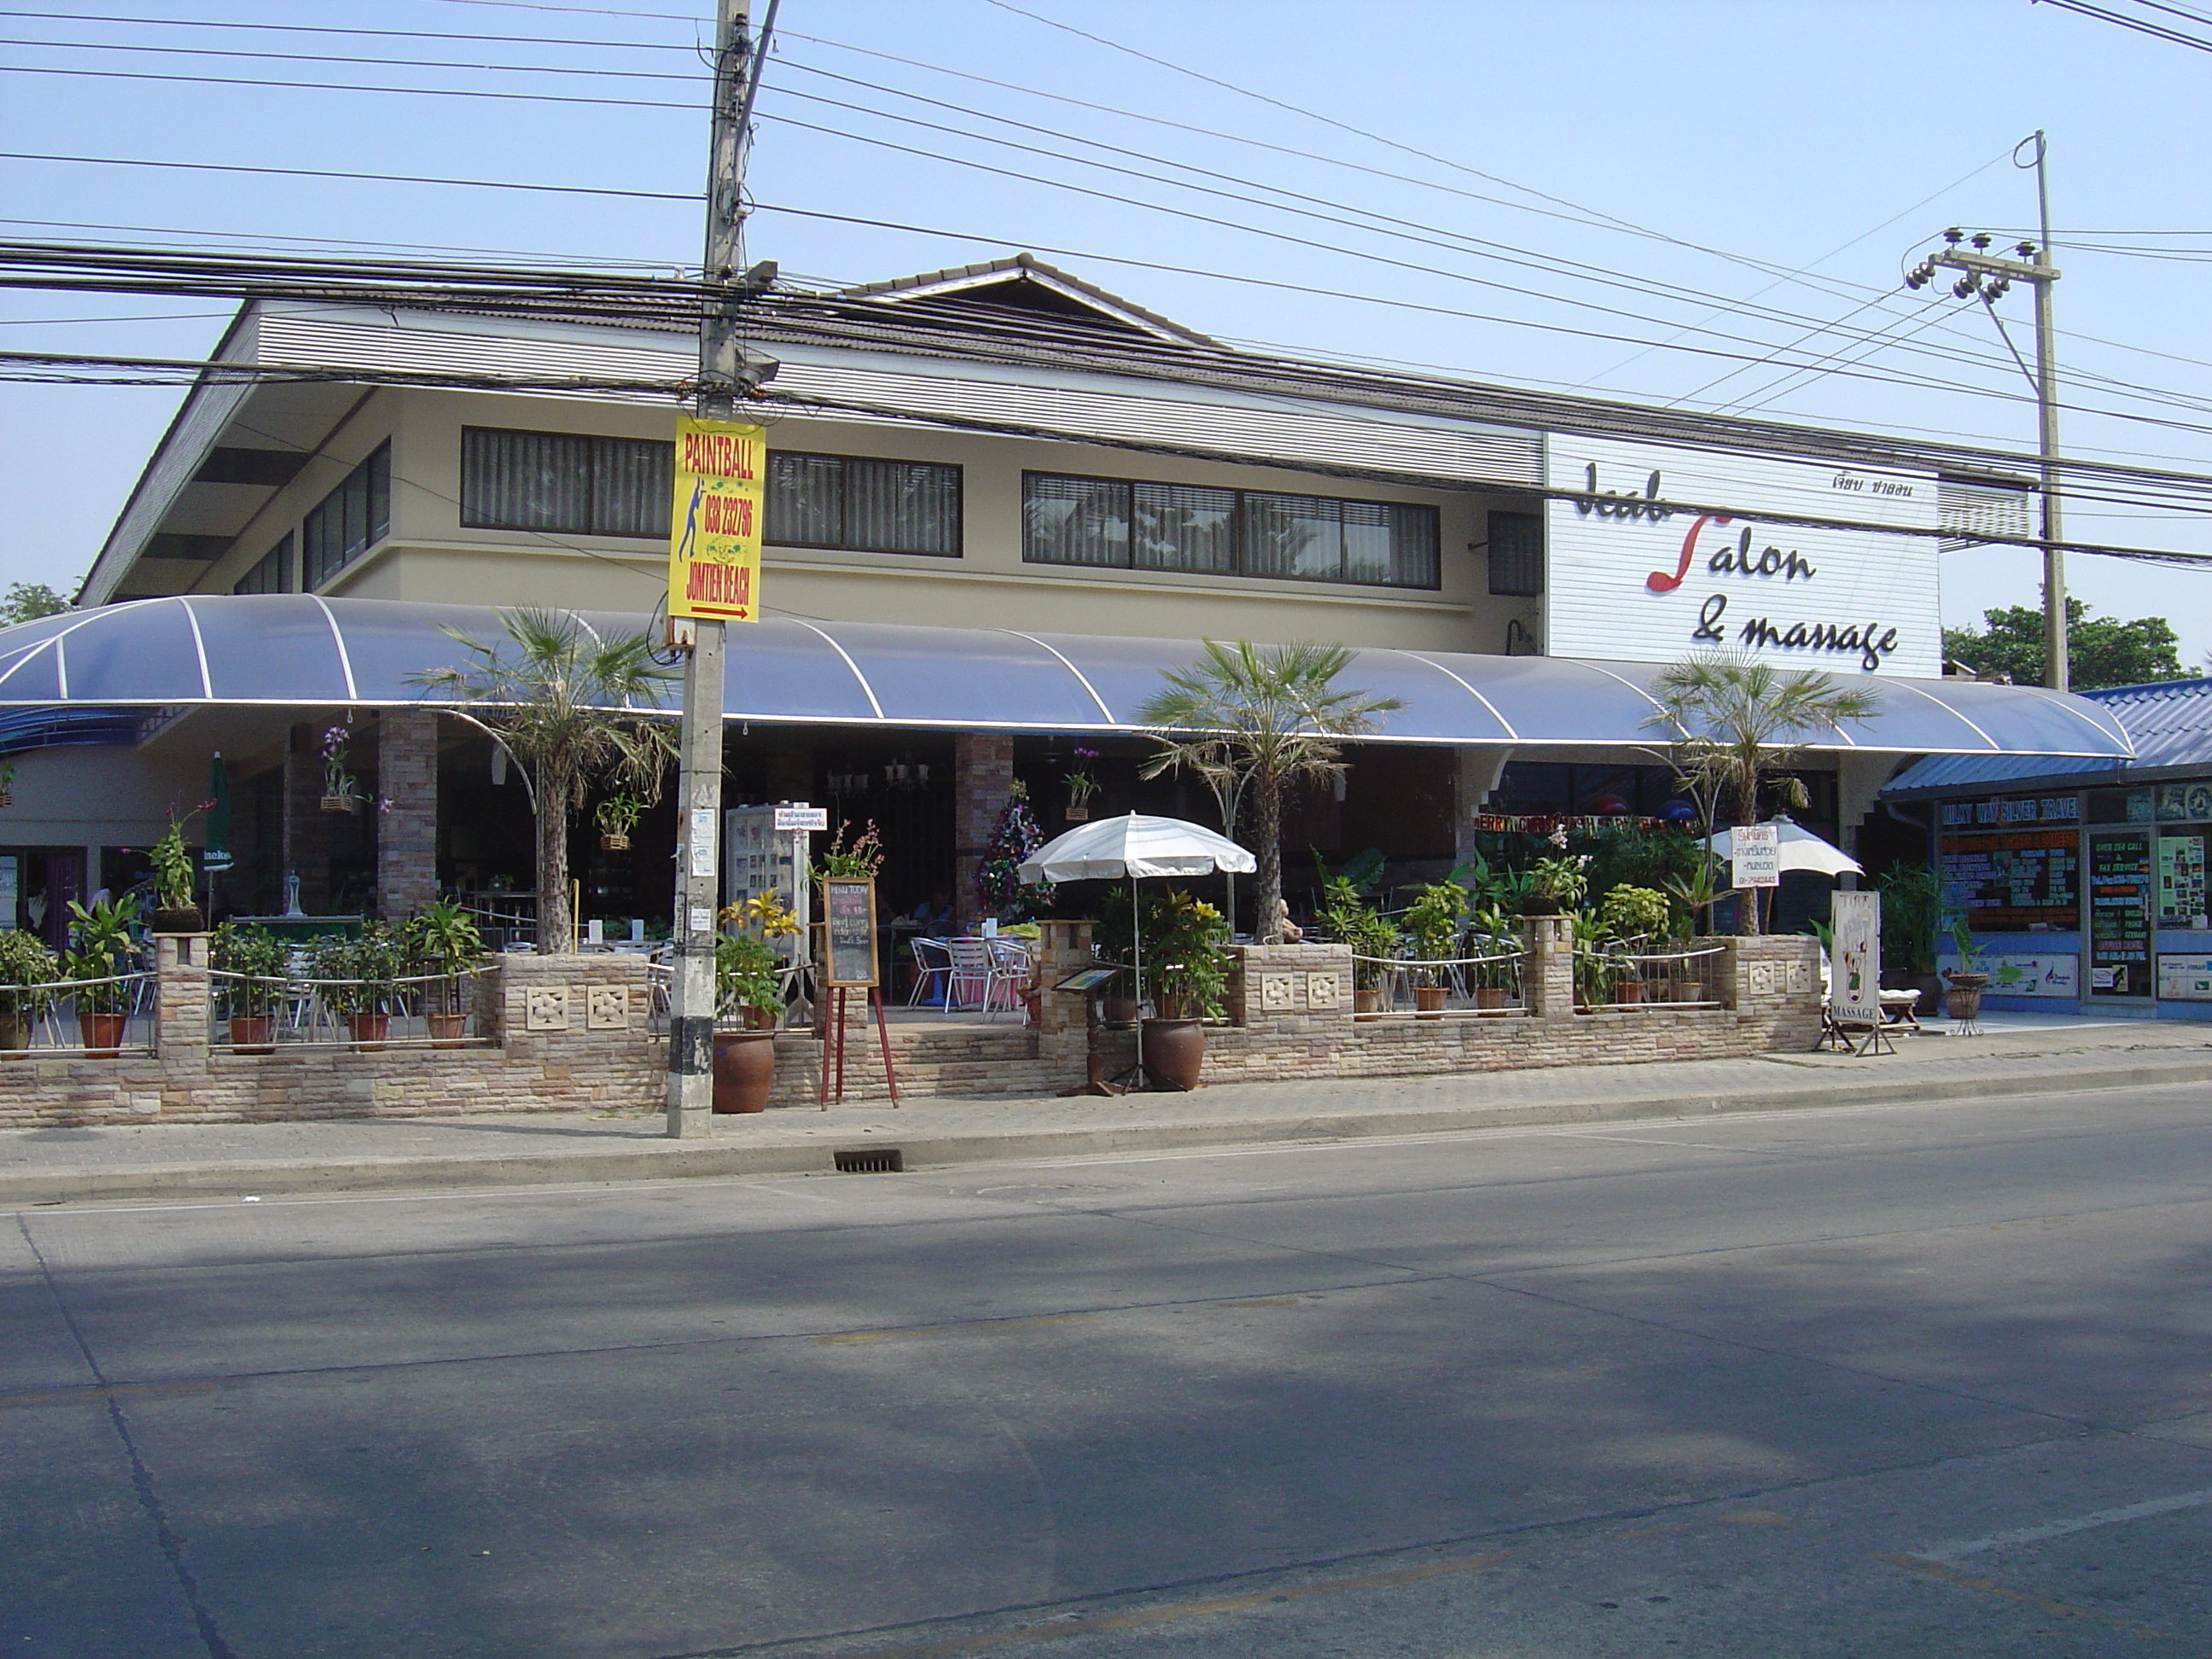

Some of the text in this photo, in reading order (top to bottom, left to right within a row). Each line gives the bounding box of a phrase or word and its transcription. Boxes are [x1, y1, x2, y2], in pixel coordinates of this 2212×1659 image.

[685, 433, 754, 480] PAINTBALL
[705, 494, 753, 538] 038 232796
[686, 562, 750, 606] JOMTIEN BEACH
[1692, 594, 1898, 671] & massage
[1942, 797, 2080, 825] MILKY WAY SILVER TRAVEL
[2128, 842, 2143, 851] CALL
[2112, 863, 2139, 872] SERVICE
[848, 885, 869, 894] TODAY
[1833, 1006, 1876, 1020] MASSAGE
